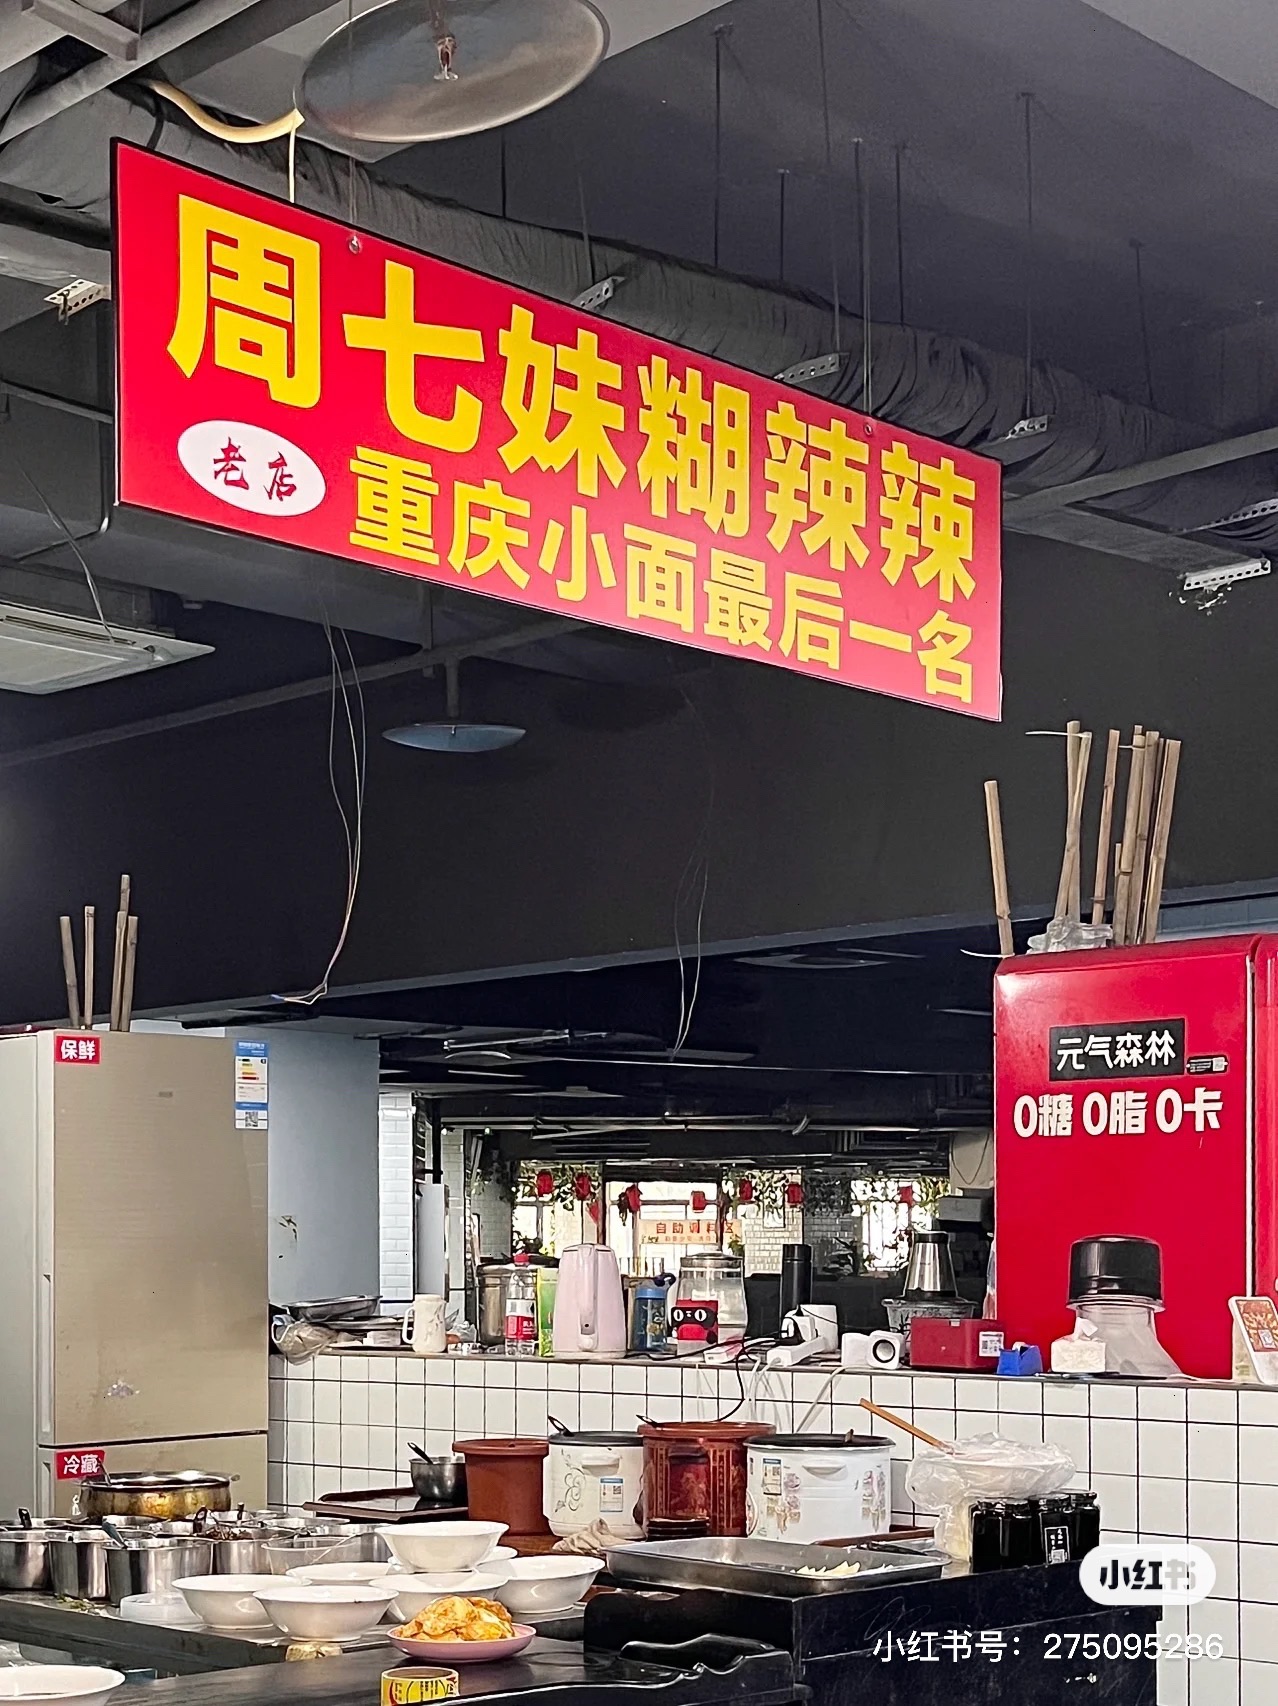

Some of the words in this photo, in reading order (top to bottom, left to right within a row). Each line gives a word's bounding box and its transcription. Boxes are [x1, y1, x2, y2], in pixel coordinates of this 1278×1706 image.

[166, 193, 977, 603] 周七妹糊辣辣
[212, 437, 297, 502] 老店
[349, 445, 973, 704] 重庆小面最后一名
[60, 1039, 96, 1060] 保鲜
[1056, 1030, 1177, 1072] 元气森林
[1013, 1092, 1074, 1138] 0糖
[1083, 1090, 1149, 1136] 0脂
[1156, 1087, 1223, 1133] 0卡
[63, 1453, 100, 1475] 冷藏
